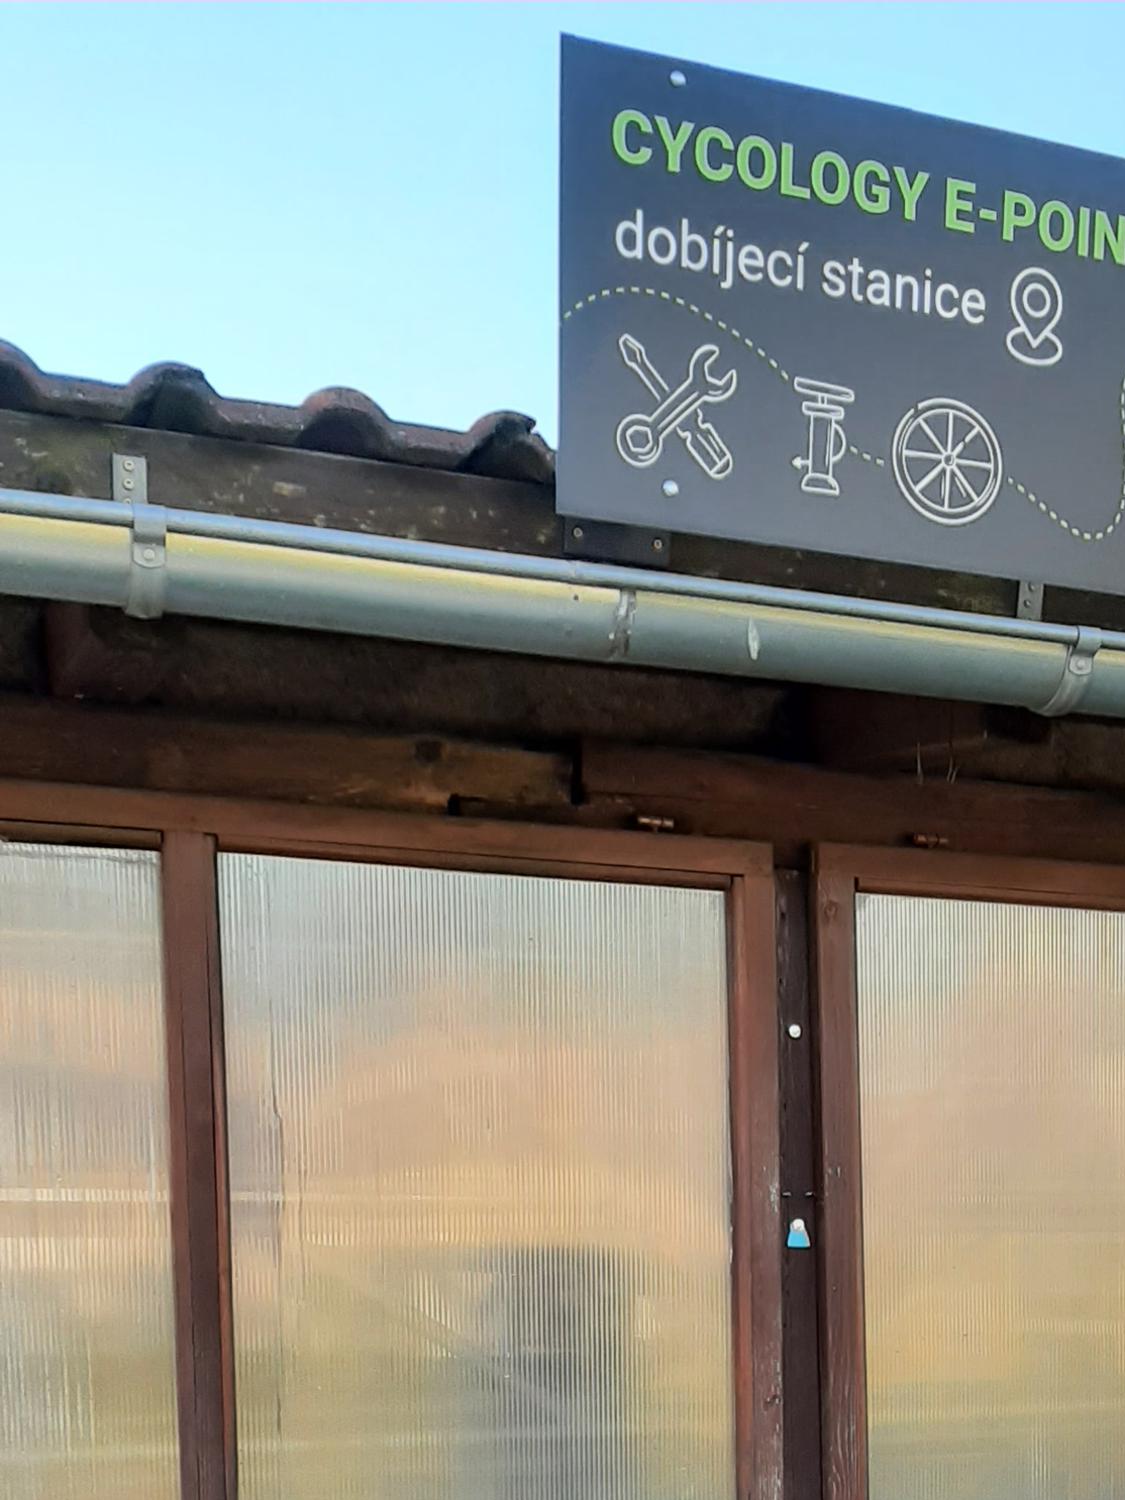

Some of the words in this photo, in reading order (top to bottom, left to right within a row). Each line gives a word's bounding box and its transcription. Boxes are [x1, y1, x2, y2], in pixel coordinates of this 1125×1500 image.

[612, 109, 929, 222] CYCOLOGY
[615, 208, 807, 291] dobíjecí
[822, 255, 987, 324] stanice
